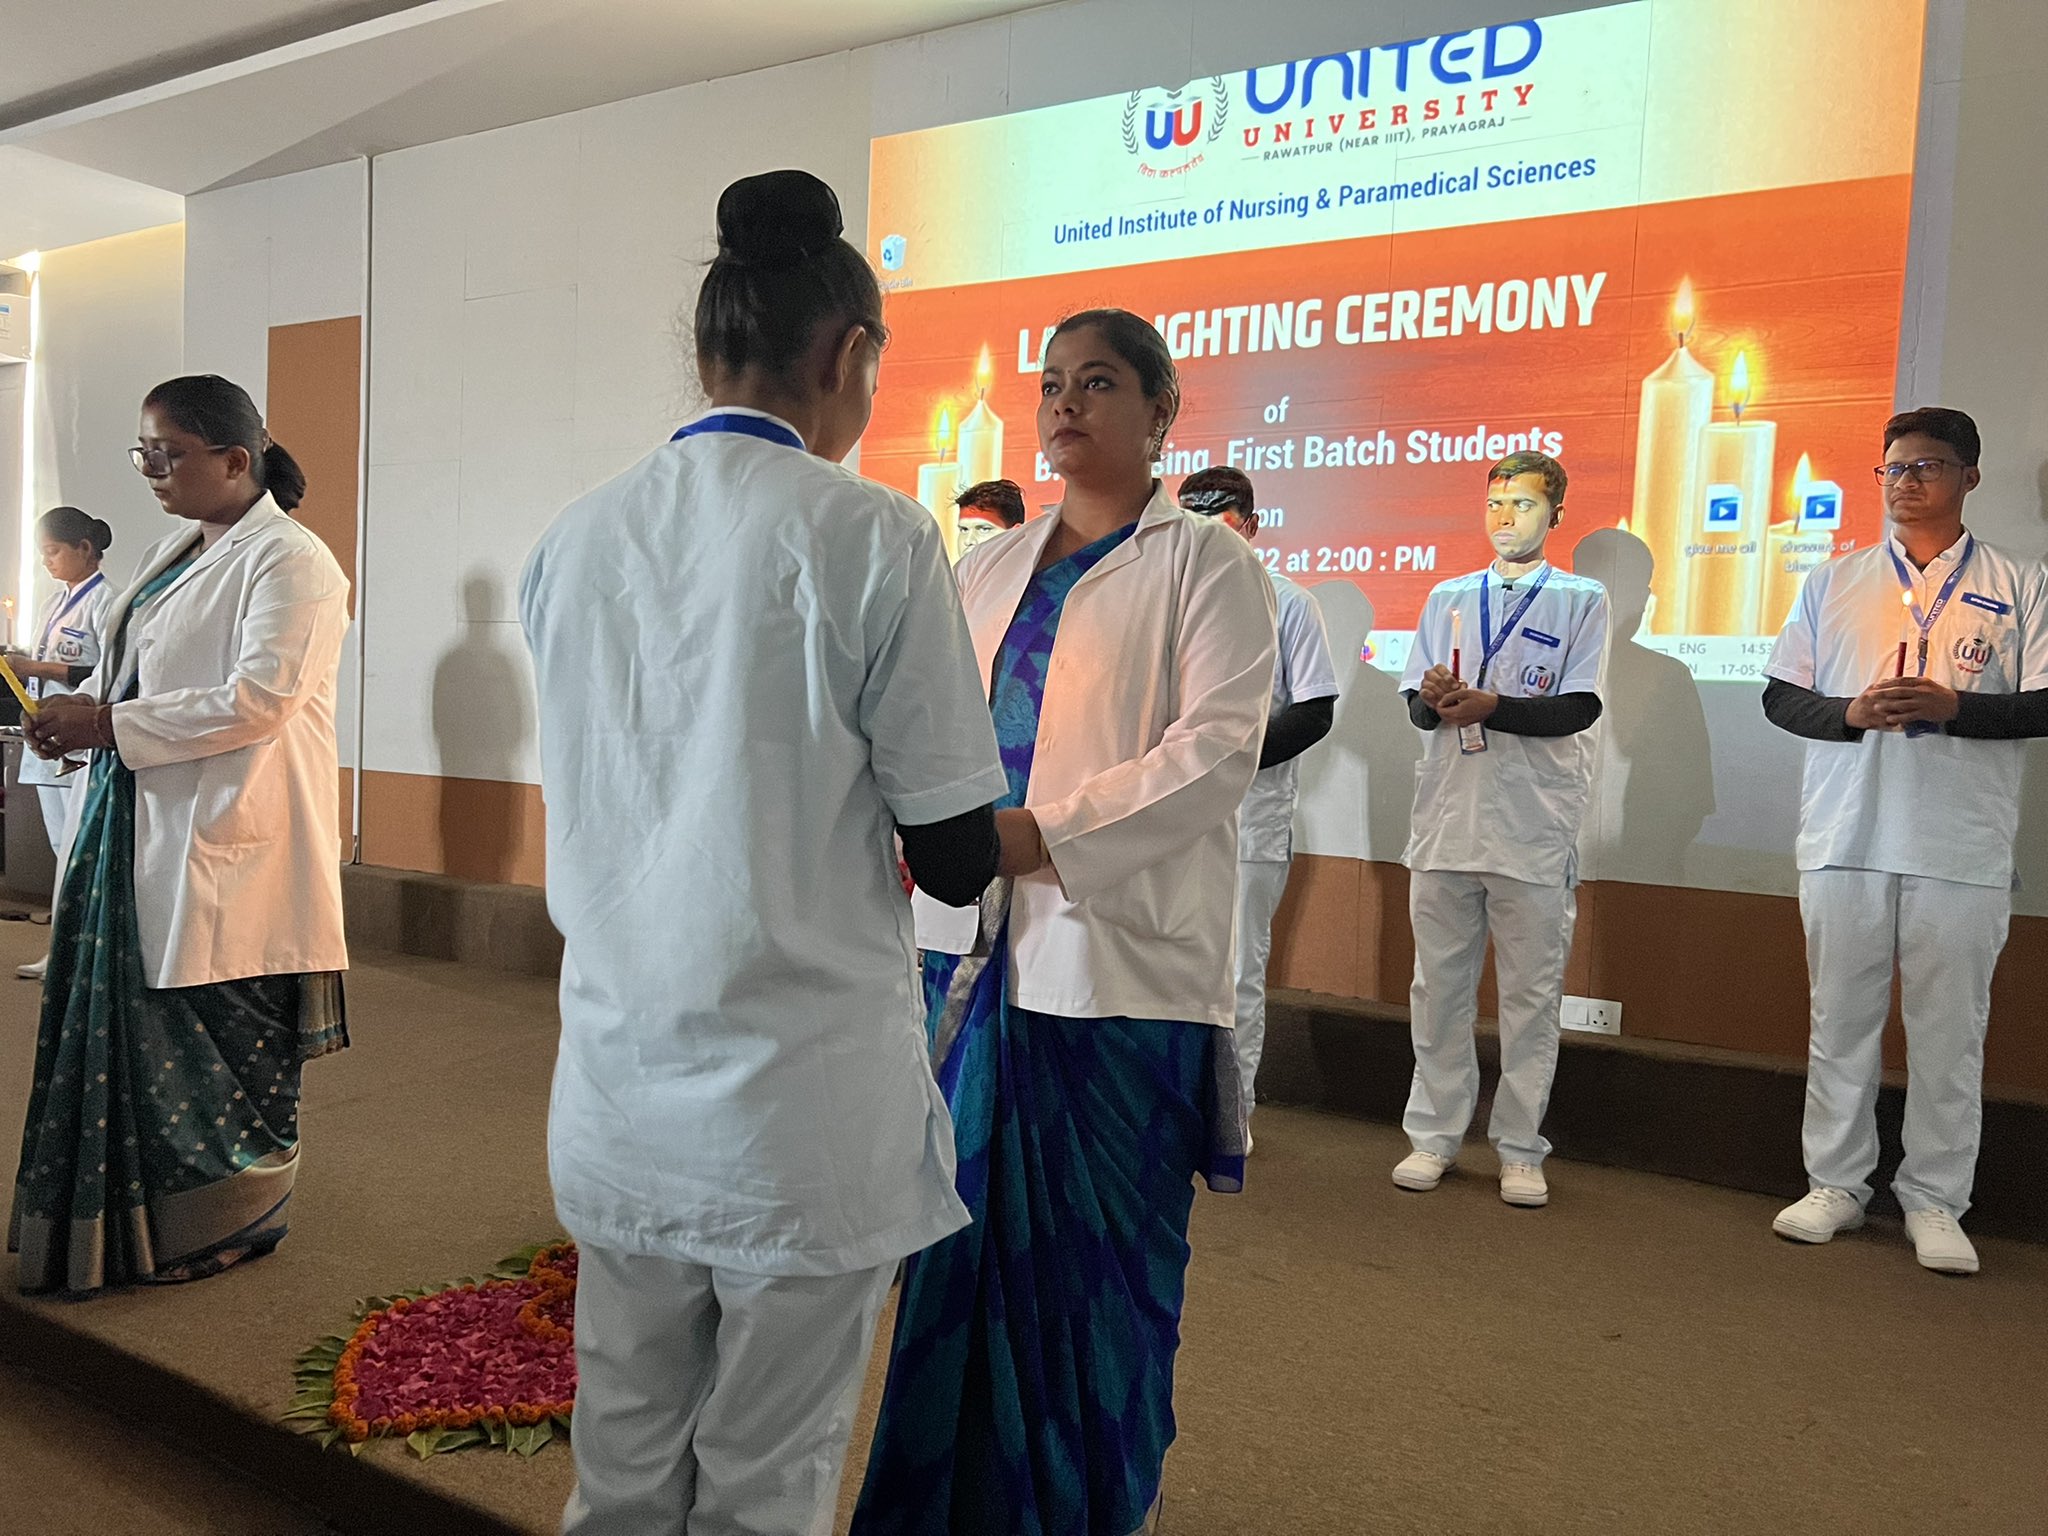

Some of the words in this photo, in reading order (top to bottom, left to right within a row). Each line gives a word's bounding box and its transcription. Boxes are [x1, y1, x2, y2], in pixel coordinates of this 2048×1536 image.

[1243, 83, 1534, 147] UNIVERSITY
[1263, 141, 1334, 161] RAWATPUR
[1339, 134, 1379, 153] (NEAR
[1422, 116, 1506, 139] PRAYAGRAJ
[1054, 216, 1112, 244] United
[1118, 209, 1197, 236] Institute
[1203, 200, 1225, 224] of
[1229, 192, 1309, 221] Nursing
[1315, 187, 1331, 209] &
[1338, 166, 1480, 207] Paramedical
[1486, 157, 1597, 188] Sciences
[1335, 272, 1608, 345] CEREMONY
[1263, 396, 1289, 424] of
[1226, 436, 1295, 472] First
[1303, 430, 1396, 468] Batch
[1405, 425, 1564, 464] Students
[1257, 506, 1284, 528] on
[1286, 548, 1310, 573] at
[1316, 546, 1373, 573] 2:00
[1394, 545, 1436, 571] PM
[1679, 643, 1707, 655] ENG
